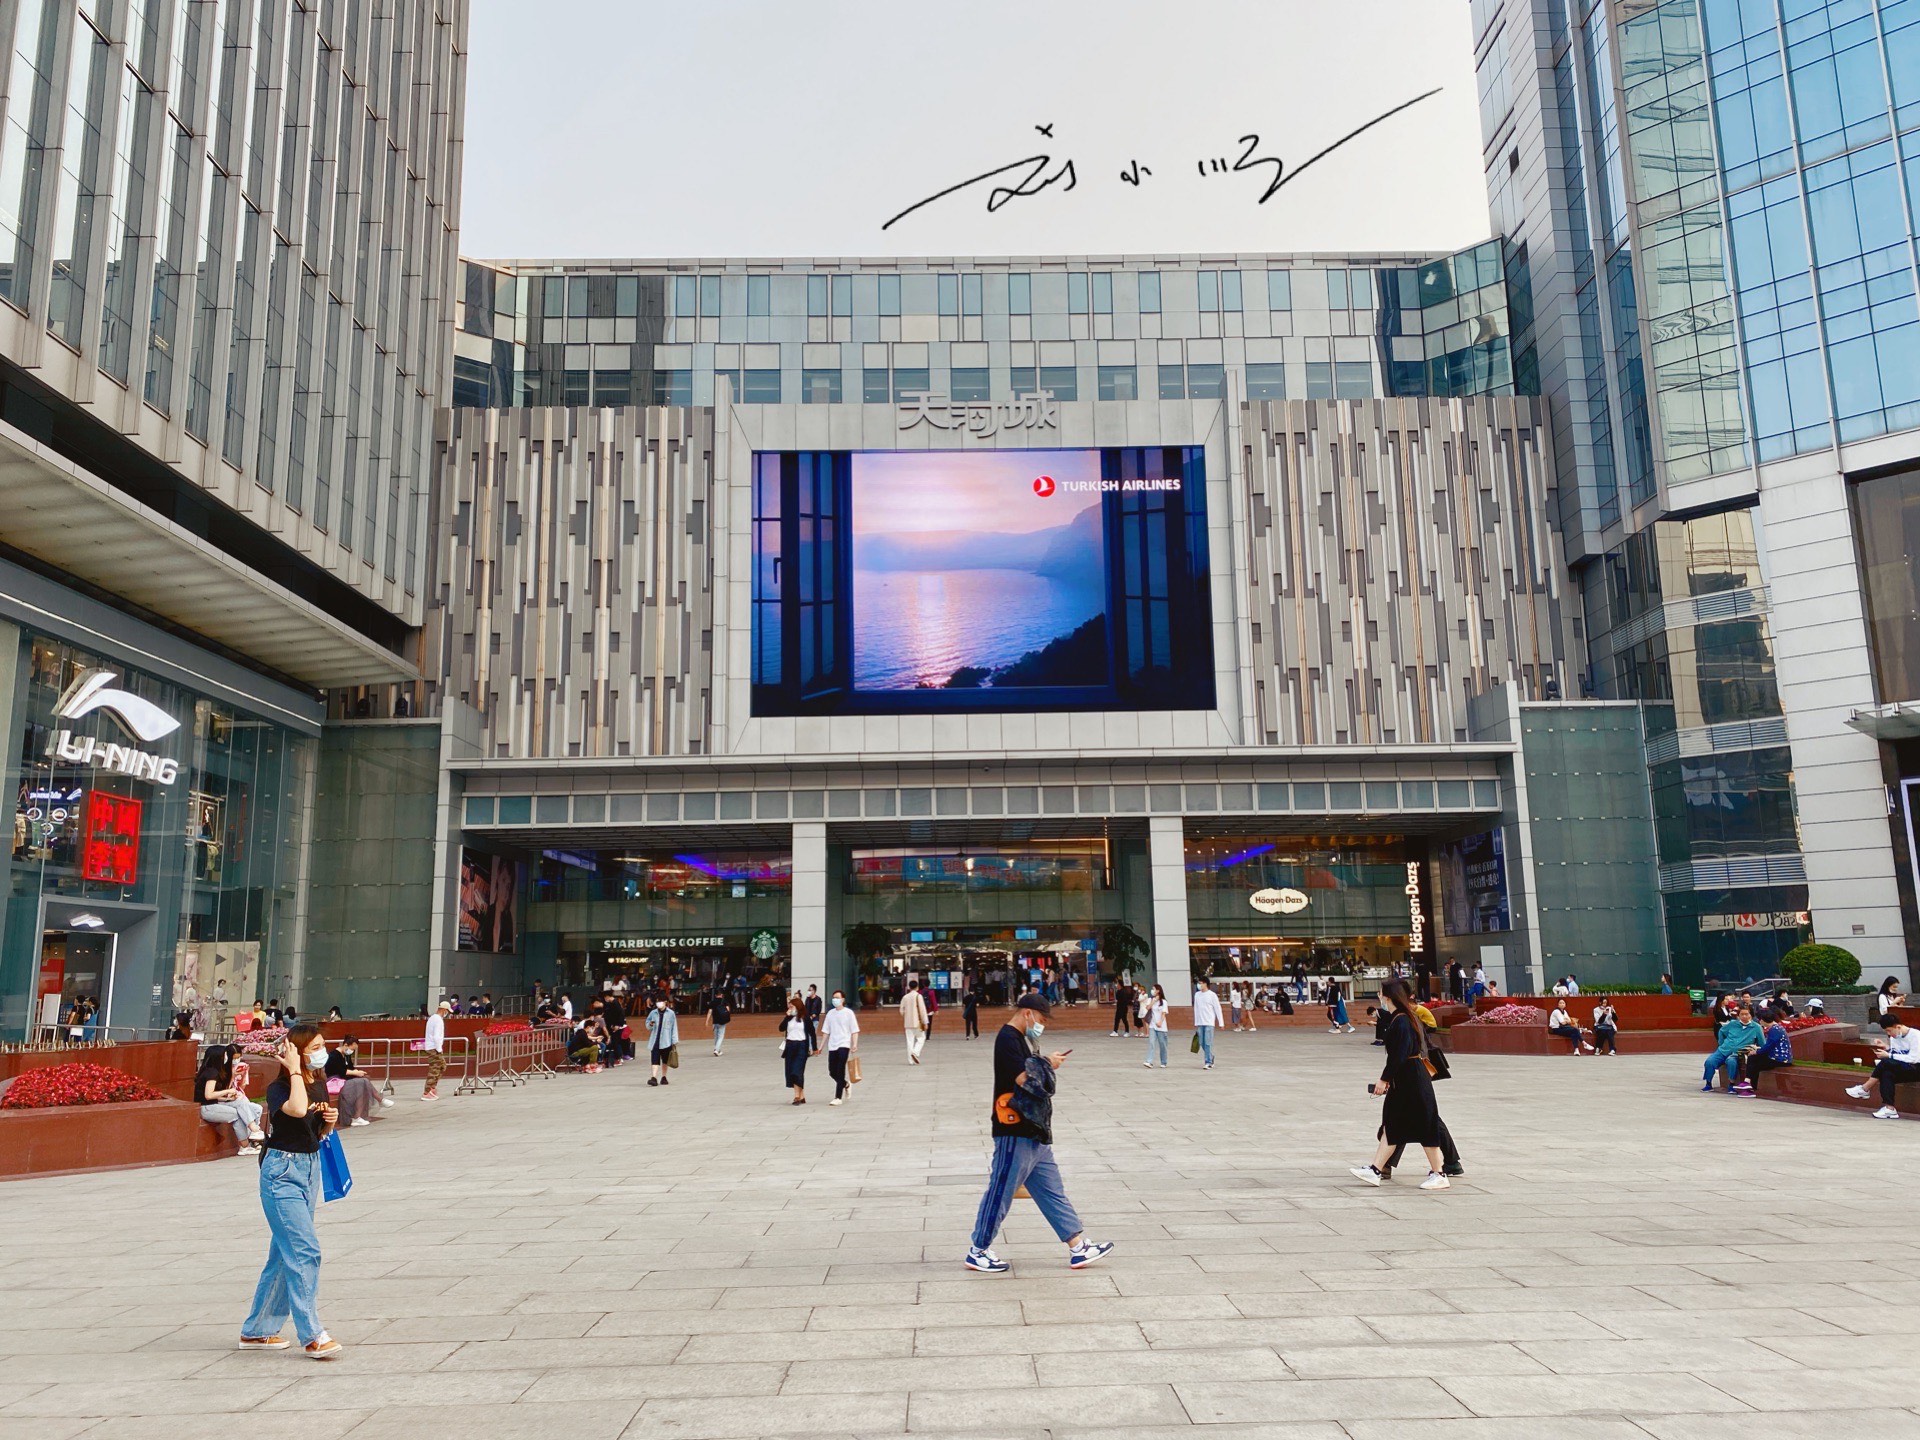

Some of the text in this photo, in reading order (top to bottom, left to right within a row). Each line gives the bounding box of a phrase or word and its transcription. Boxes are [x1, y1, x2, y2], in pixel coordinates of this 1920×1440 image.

[899, 390, 1056, 438] 天河城
[1062, 479, 1181, 491] TURKISH AIRLINES
[57, 729, 179, 785] LI-NING
[603, 937, 724, 949] STARBUCKS COFFEE
